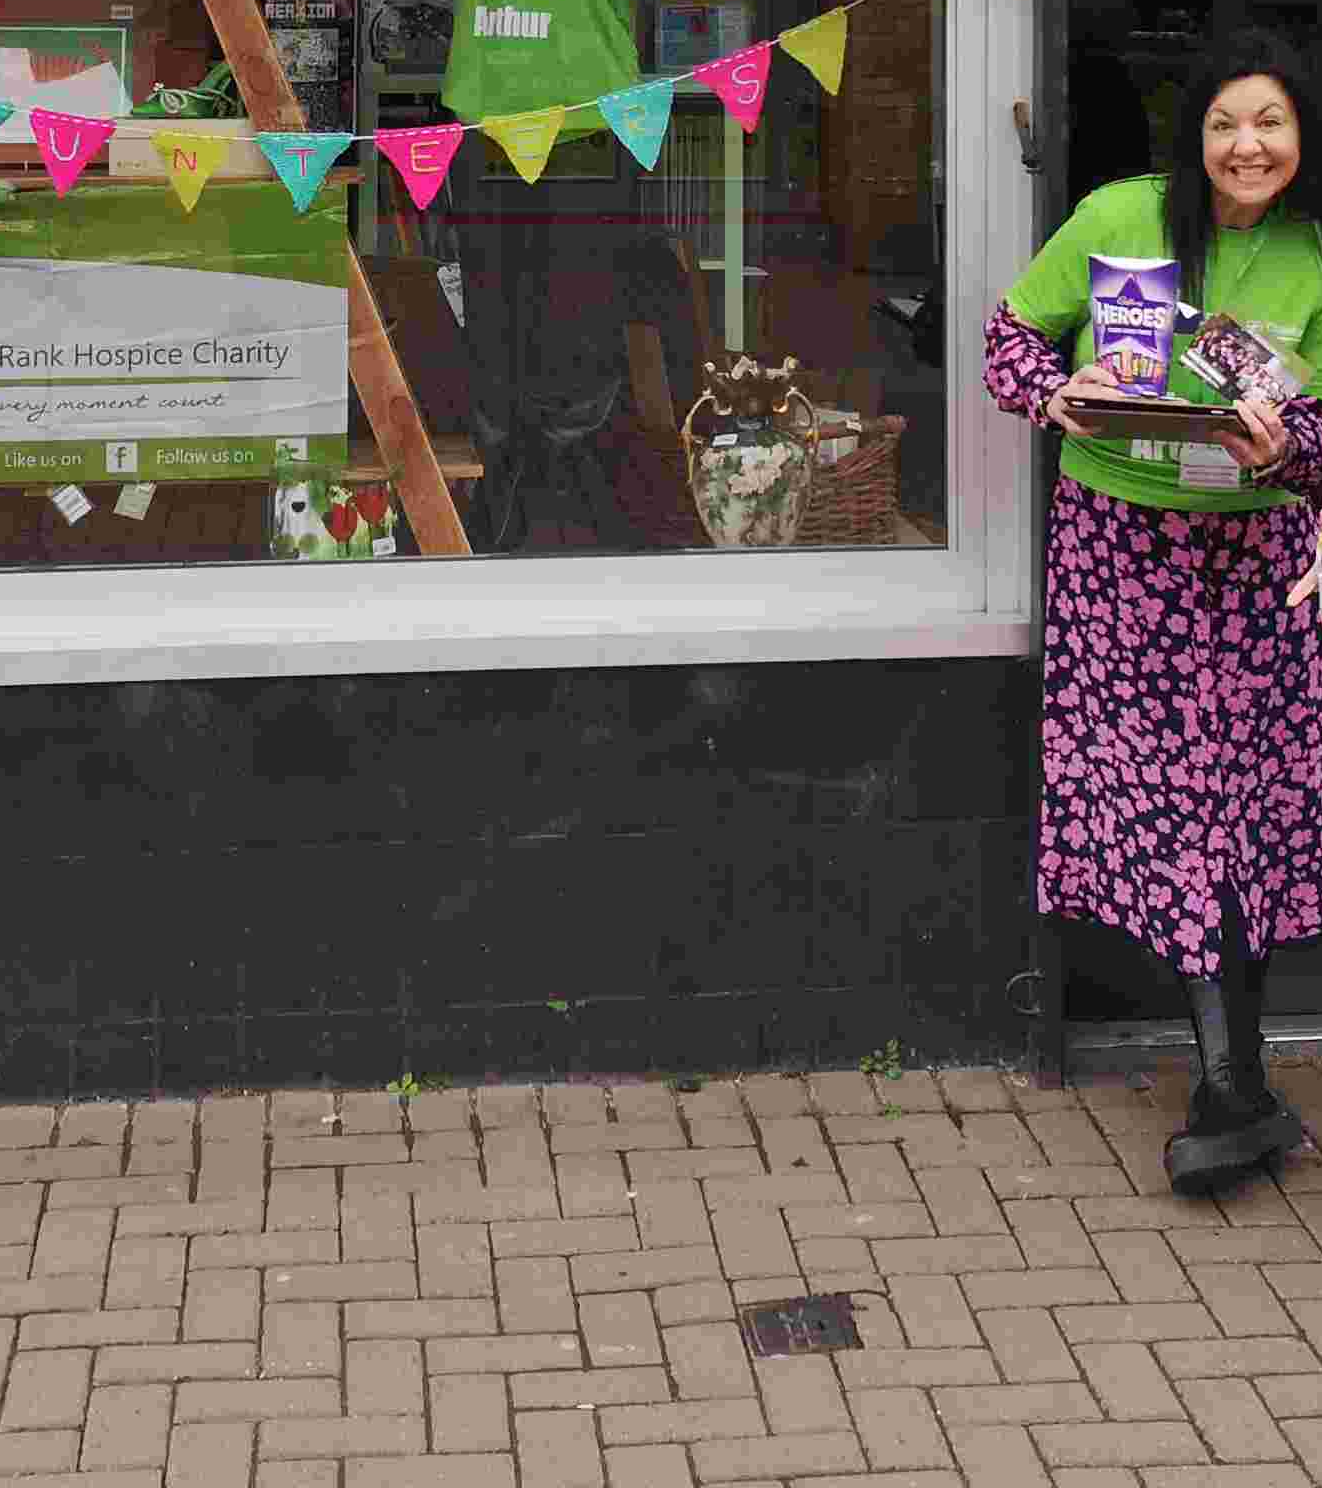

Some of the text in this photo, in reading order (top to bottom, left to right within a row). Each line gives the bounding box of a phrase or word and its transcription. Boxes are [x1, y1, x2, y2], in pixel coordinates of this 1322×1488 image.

[474, 6, 552, 39] Arthur
[1093, 301, 1166, 328] HEROES
[75, 342, 183, 372] Hospice
[192, 336, 290, 371] Charity
[55, 392, 151, 410] moment
[4, 450, 37, 468] Like
[40, 454, 60, 468] us
[63, 453, 82, 468] on
[155, 448, 254, 466] Follow us on
